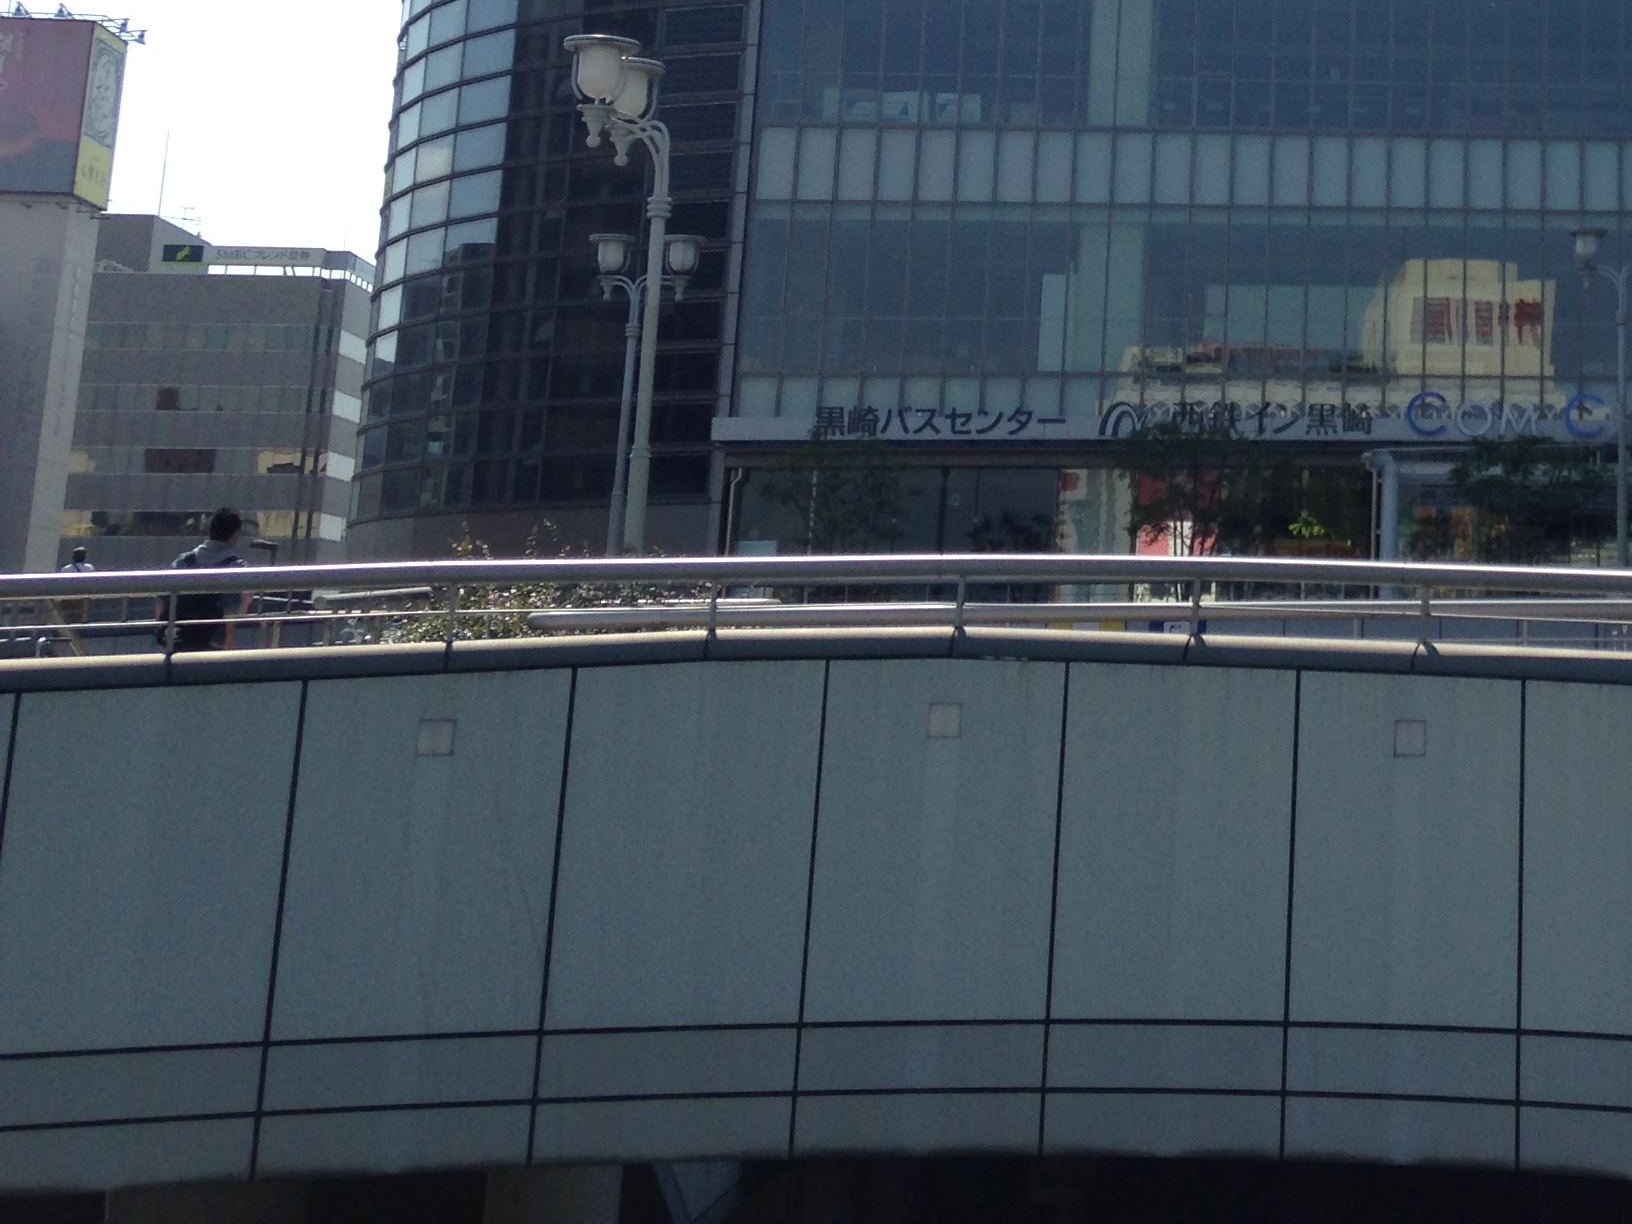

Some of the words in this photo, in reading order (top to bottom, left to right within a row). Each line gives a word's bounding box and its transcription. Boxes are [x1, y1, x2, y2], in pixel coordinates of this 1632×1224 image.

[815, 405, 1067, 438] 黒崎バスセンター
[1407, 391, 1540, 437] COM
